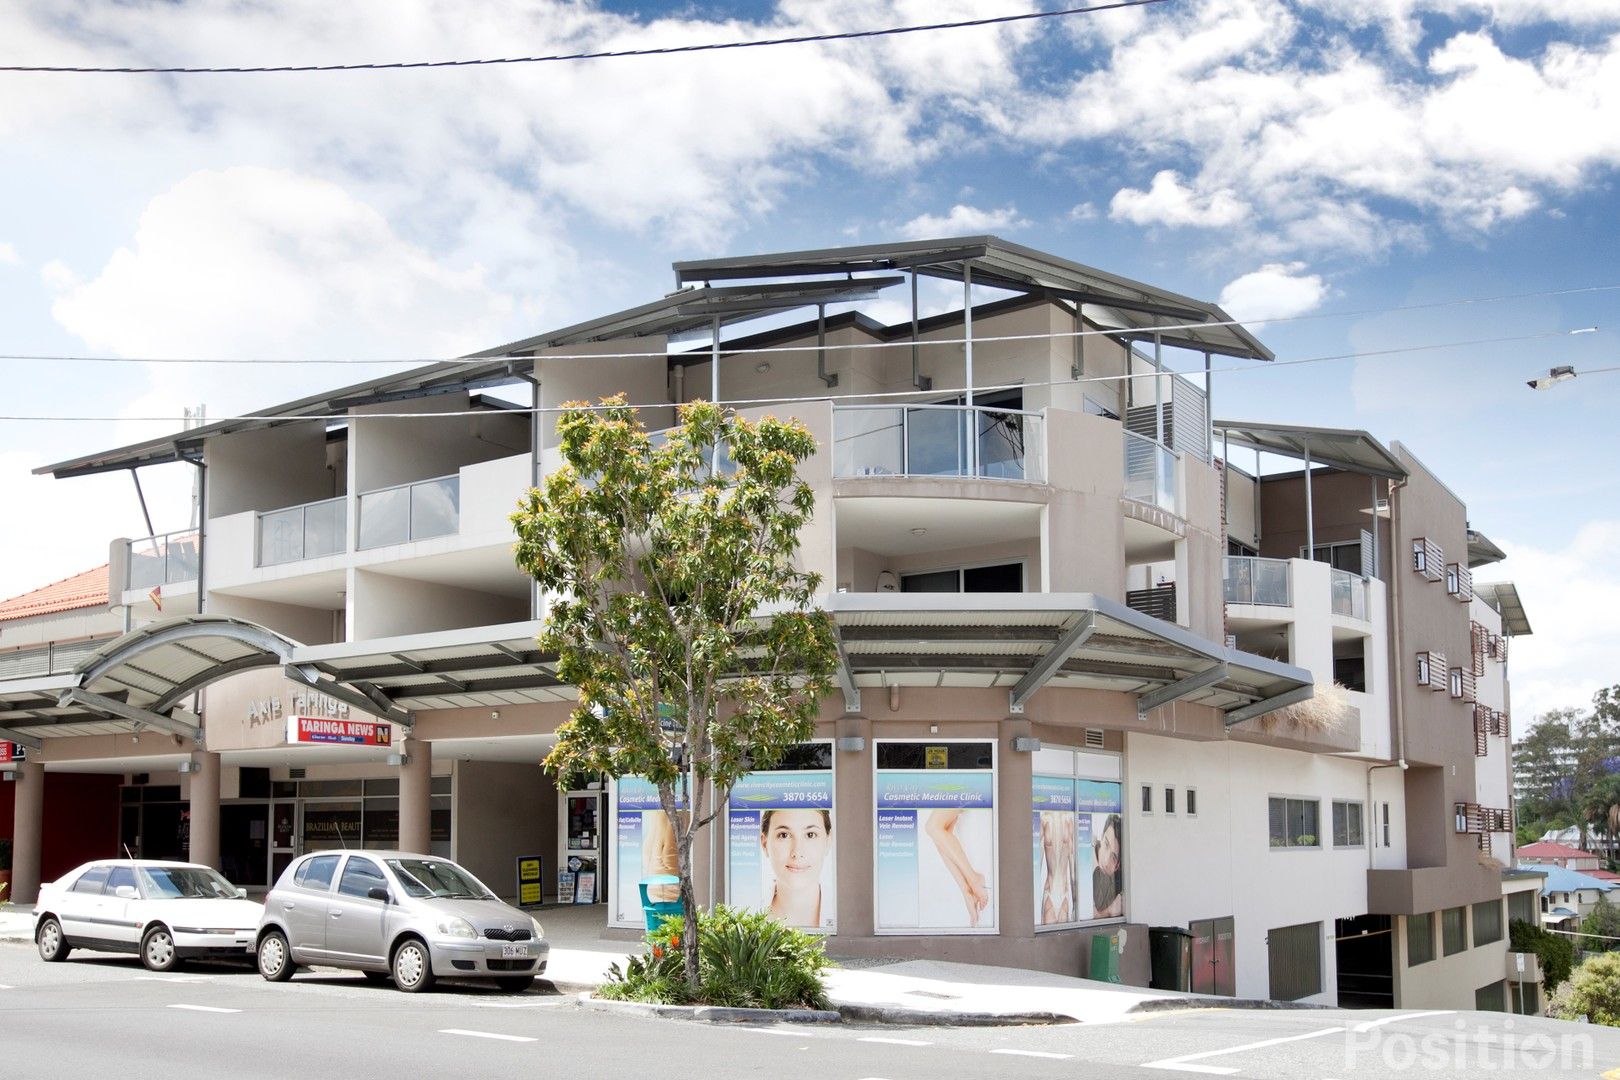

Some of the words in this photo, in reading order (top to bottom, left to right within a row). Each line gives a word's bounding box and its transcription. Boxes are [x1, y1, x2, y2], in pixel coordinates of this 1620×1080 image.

[301, 720, 345, 735] TARINGA
[347, 724, 374, 736] NEWS
[377, 727, 389, 742] N
[620, 795, 645, 803] Cosmetic
[783, 793, 804, 801] 3870
[806, 792, 828, 801] 5654
[884, 793, 920, 801] Cosmetic
[921, 792, 958, 801] Medicine
[960, 792, 983, 801] Clinic
